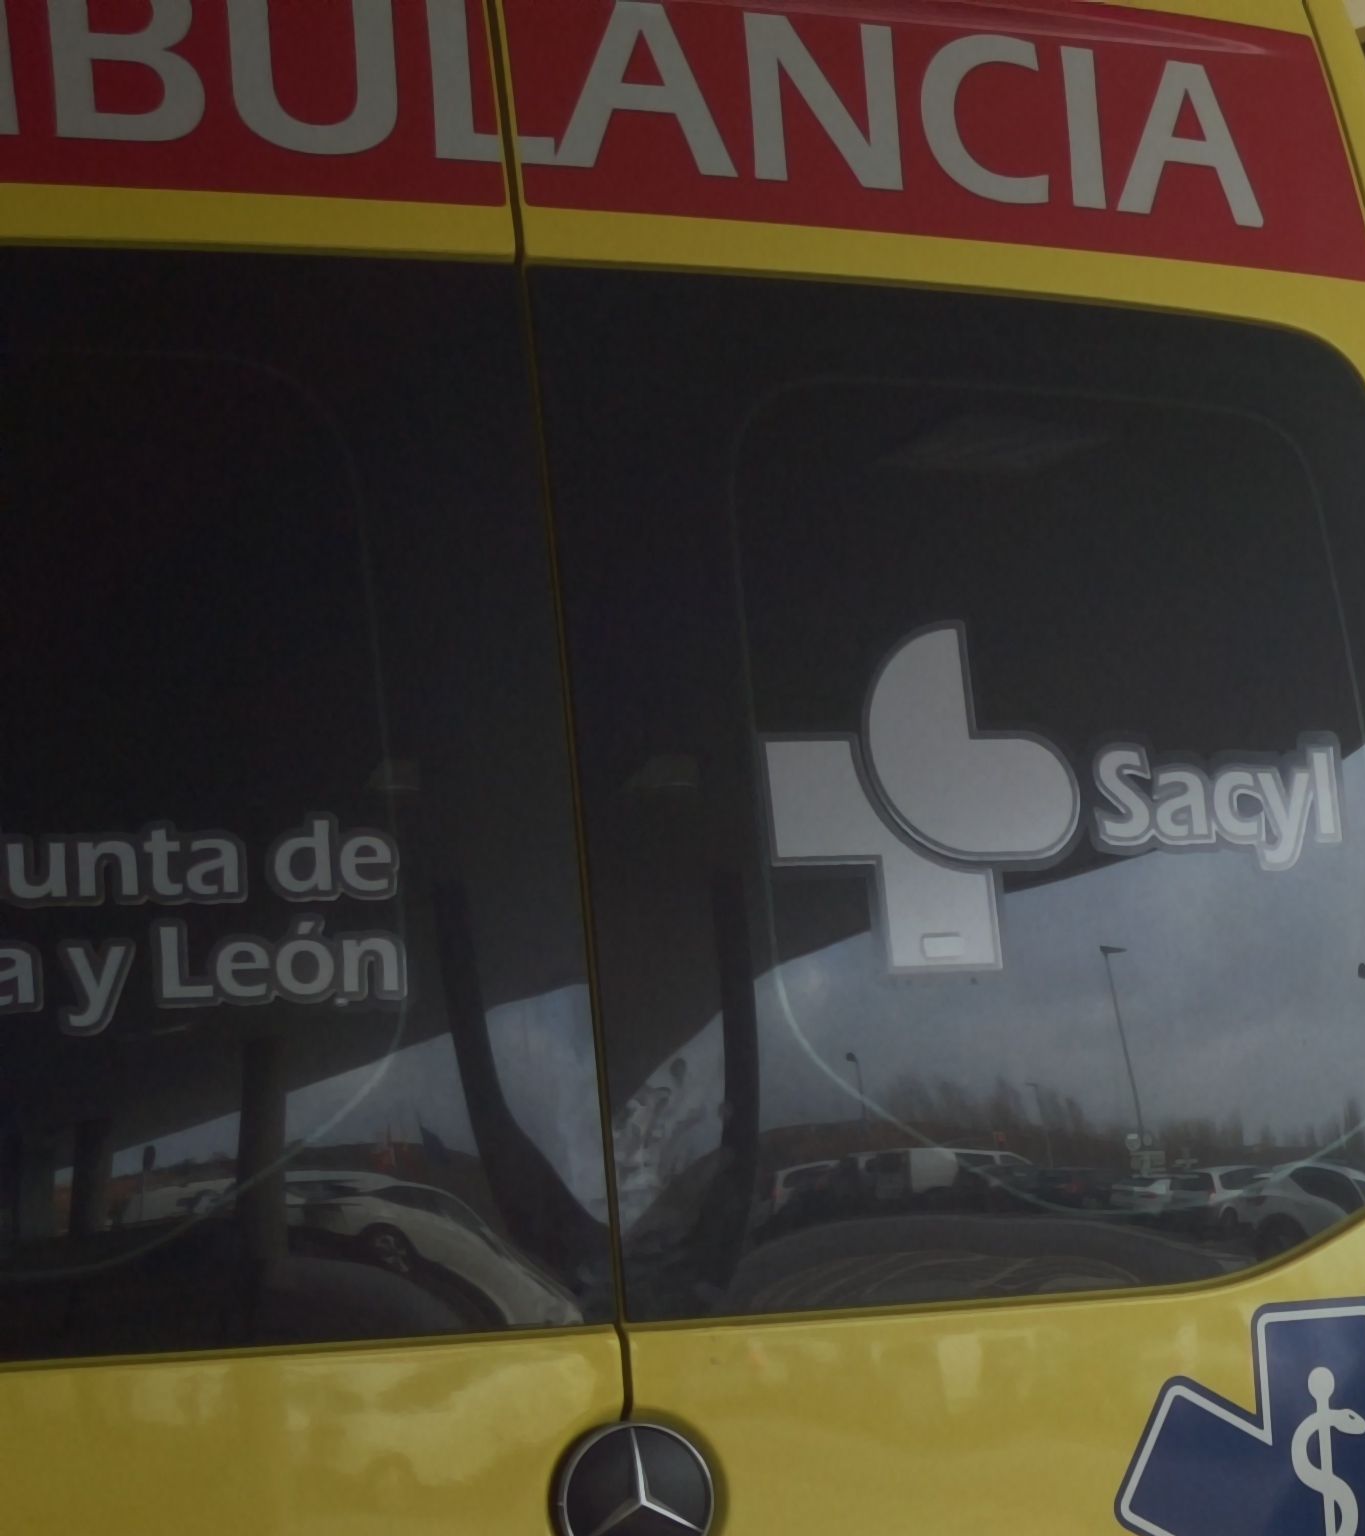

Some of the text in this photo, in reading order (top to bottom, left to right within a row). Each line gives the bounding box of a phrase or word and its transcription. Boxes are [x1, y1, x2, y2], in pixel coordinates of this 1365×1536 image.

[0, 0, 1266, 228] BULANCIA
[274, 819, 393, 893] de
[1099, 744, 1342, 868] Sacyl
[67, 944, 126, 1027] y
[158, 920, 401, 999] León
